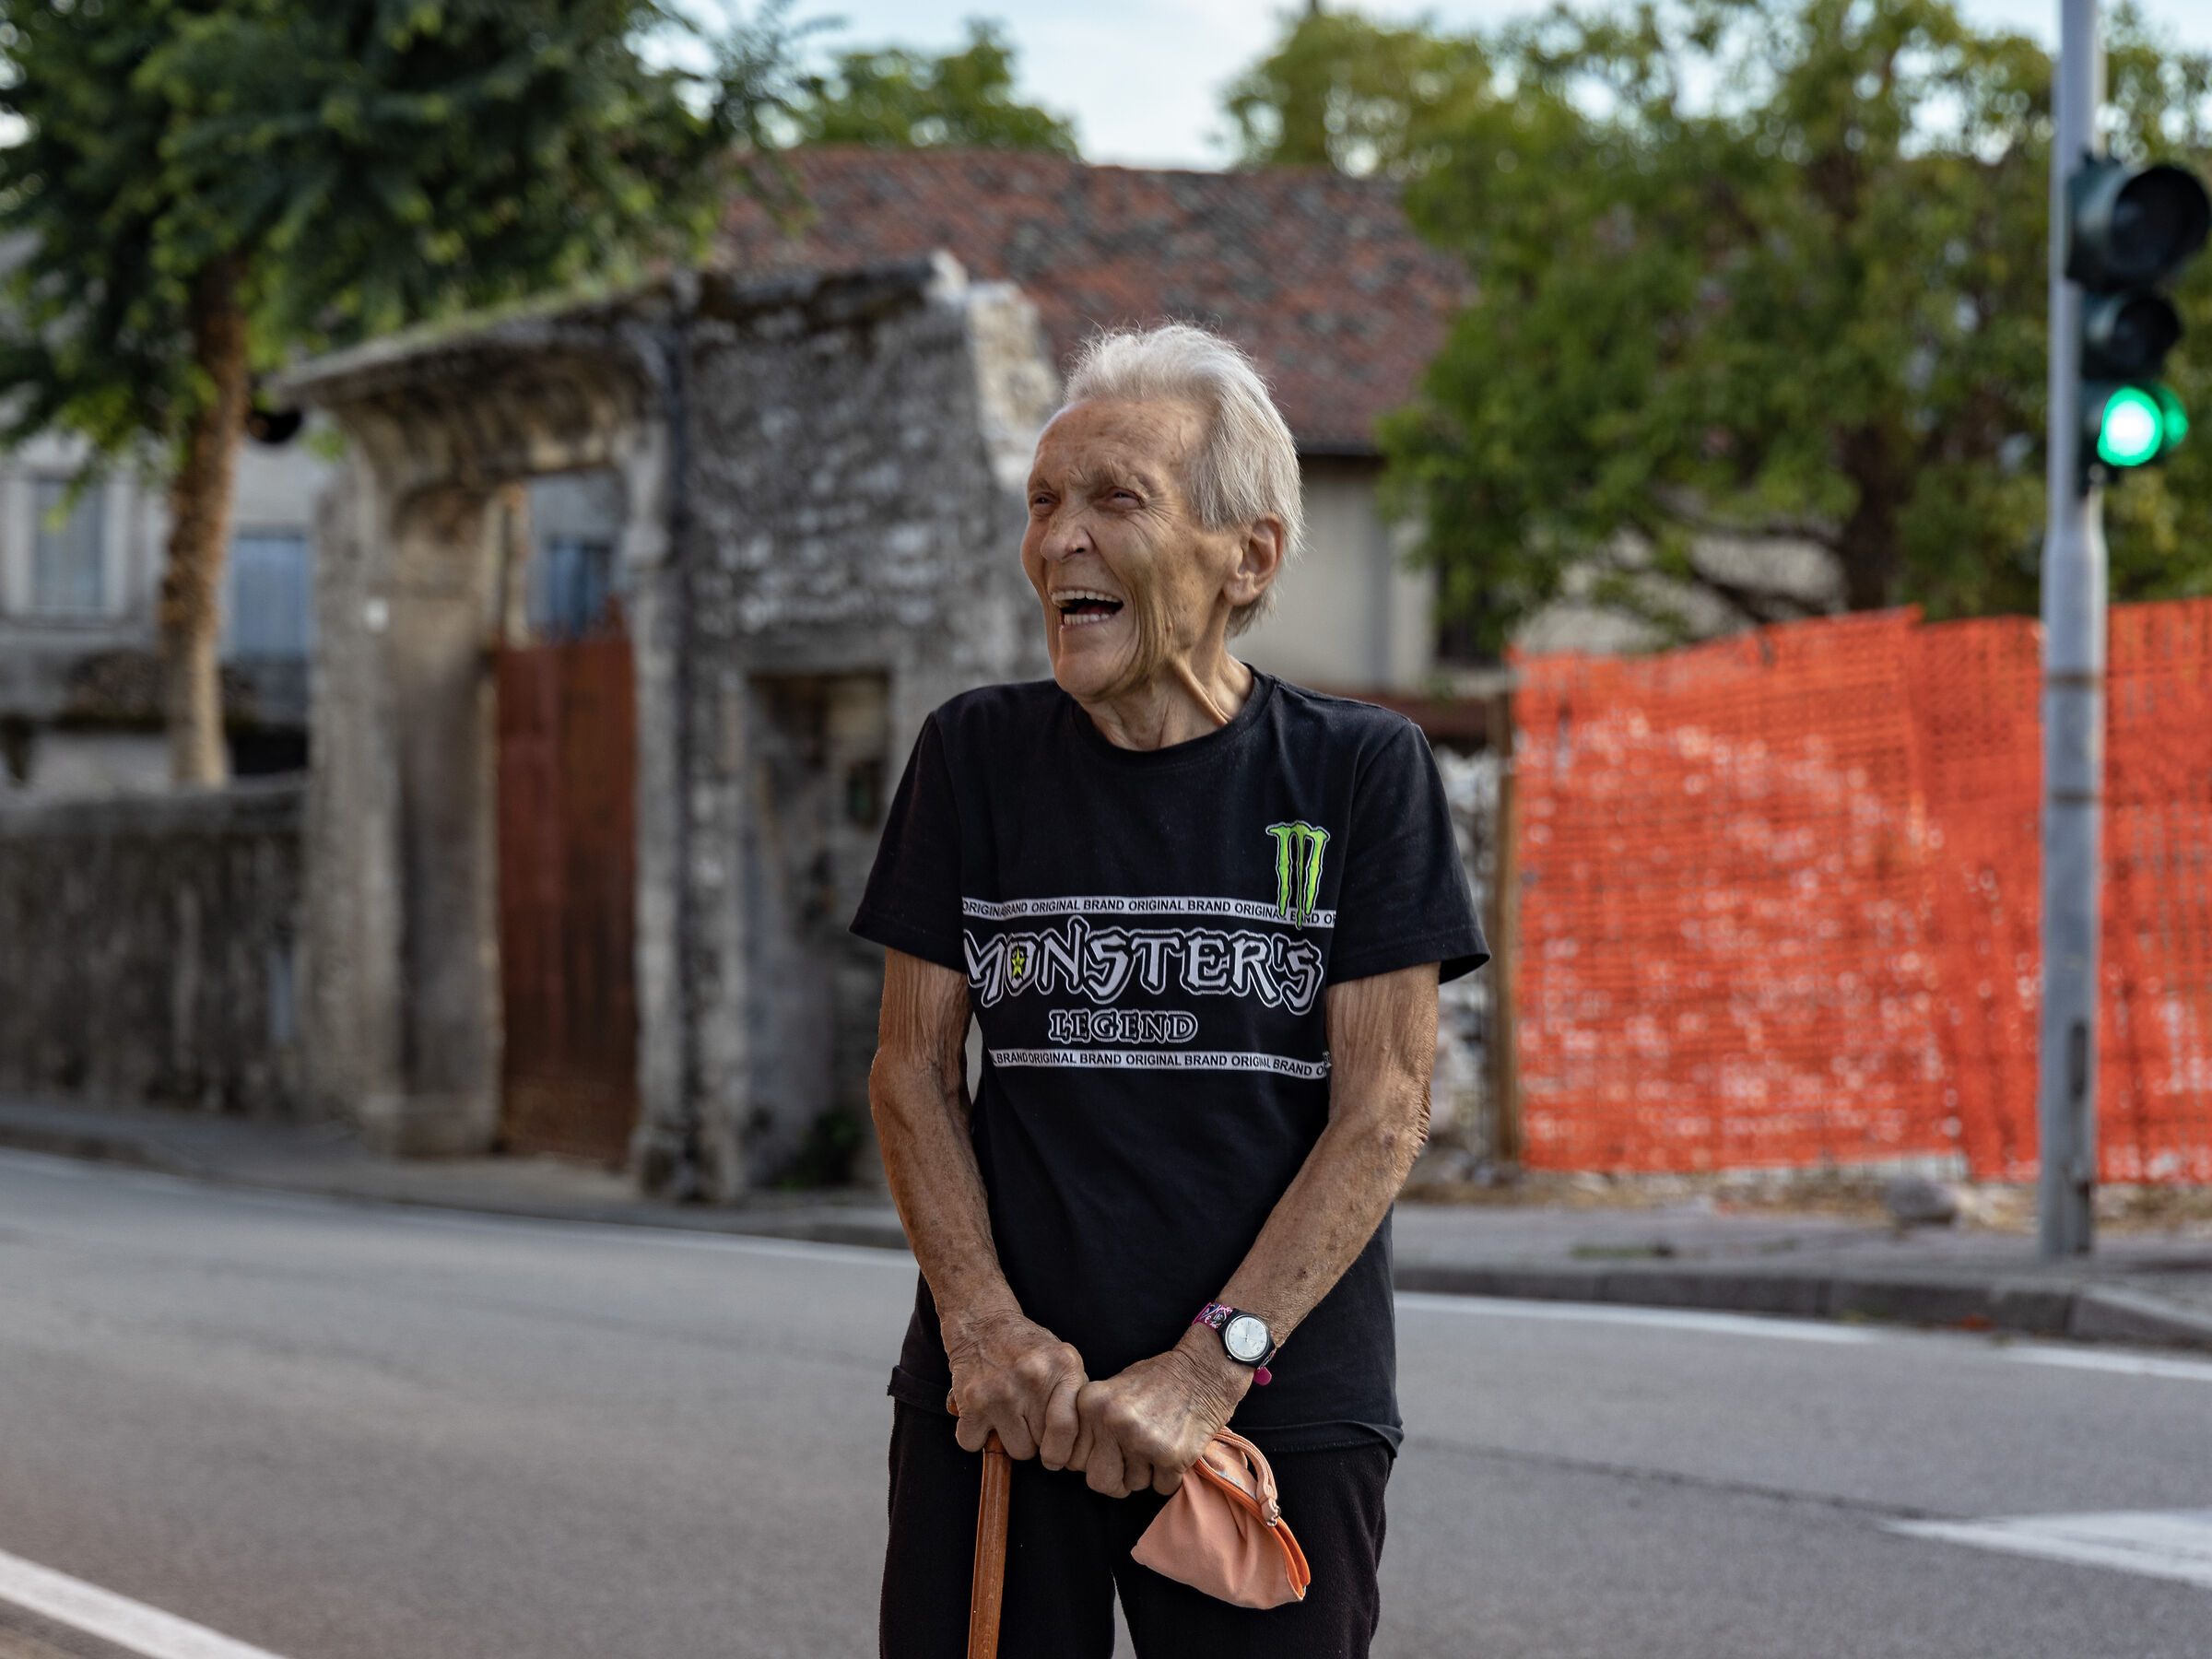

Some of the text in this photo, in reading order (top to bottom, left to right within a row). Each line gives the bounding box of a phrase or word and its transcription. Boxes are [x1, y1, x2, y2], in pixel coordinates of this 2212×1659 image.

[1031, 900, 1080, 913] ORIGINAL
[1083, 899, 1124, 912] BRAND
[1128, 900, 1184, 912] ORIGINAL
[1187, 900, 1231, 912] BRAND
[1049, 1008, 1198, 1043] LEGEND
[996, 1052, 1028, 1064] BRAND
[1029, 1053, 1077, 1065] ORIGINAL
[1079, 1053, 1122, 1065] BRAND
[1125, 1053, 1182, 1066] ORIGINAL
[1184, 1054, 1228, 1066] BRAND
[1273, 1059, 1312, 1077] BRAND
